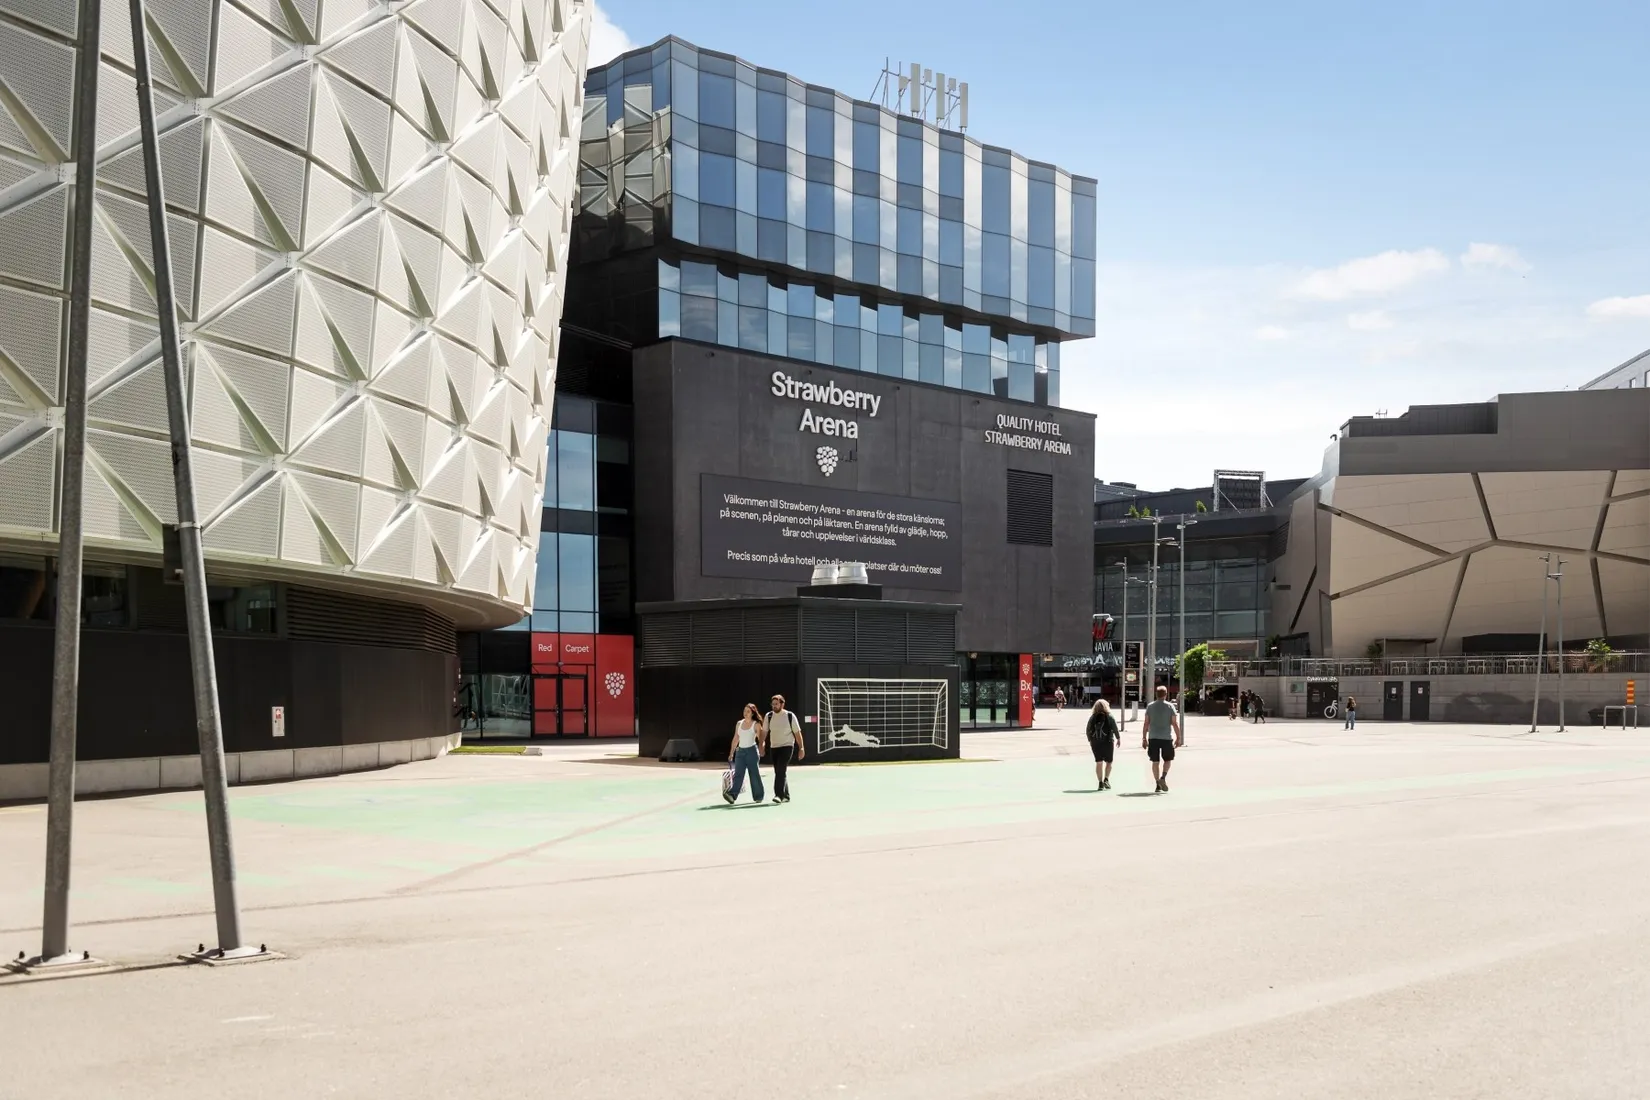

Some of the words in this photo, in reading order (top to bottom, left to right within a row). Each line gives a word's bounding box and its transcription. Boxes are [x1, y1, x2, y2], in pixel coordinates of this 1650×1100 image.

[771, 371, 881, 417] Strawberry
[799, 408, 858, 439] Arena
[996, 413, 1033, 431] QUALITY
[1034, 420, 1062, 436] HOTEL
[984, 430, 1042, 450] STRAWBERRY
[1043, 439, 1071, 455] ARENA
[723, 493, 768, 507] Välkommen
[769, 499, 778, 508] till
[779, 500, 819, 514] Strawberry
[819, 504, 841, 515] Arena
[846, 508, 855, 516] en
[856, 509, 875, 518] arena
[876, 509, 886, 519] för
[887, 511, 895, 520] de
[896, 513, 912, 522] stora
[720, 507, 730, 519] på
[731, 509, 761, 522] scenen,
[762, 511, 772, 523] på
[773, 512, 798, 524] planen
[799, 515, 812, 525] och
[813, 516, 822, 527] på
[823, 517, 853, 529] läktaren.
[854, 521, 863, 530] En
[864, 523, 883, 532] arena
[884, 523, 898, 534] fylld
[907, 526, 929, 538] glädje,
[929, 528, 948, 539] hopp,
[782, 526, 799, 538] tårar
[800, 530, 814, 539] och
[815, 531, 855, 542] upplevelser
[859, 534, 897, 546] världsklass.
[727, 550, 750, 561] Precis
[751, 553, 768, 562] som
[768, 552, 778, 565] på
[779, 553, 795, 564] våra
[795, 555, 815, 565] hotell
[816, 557, 829, 566] och
[888, 562, 899, 571] där
[900, 563, 908, 572] du
[909, 564, 929, 573] möter
[929, 566, 942, 574] oss!
[538, 643, 553, 652] Red
[565, 644, 589, 654] Carpet
[1020, 679, 1031, 691] Bx
